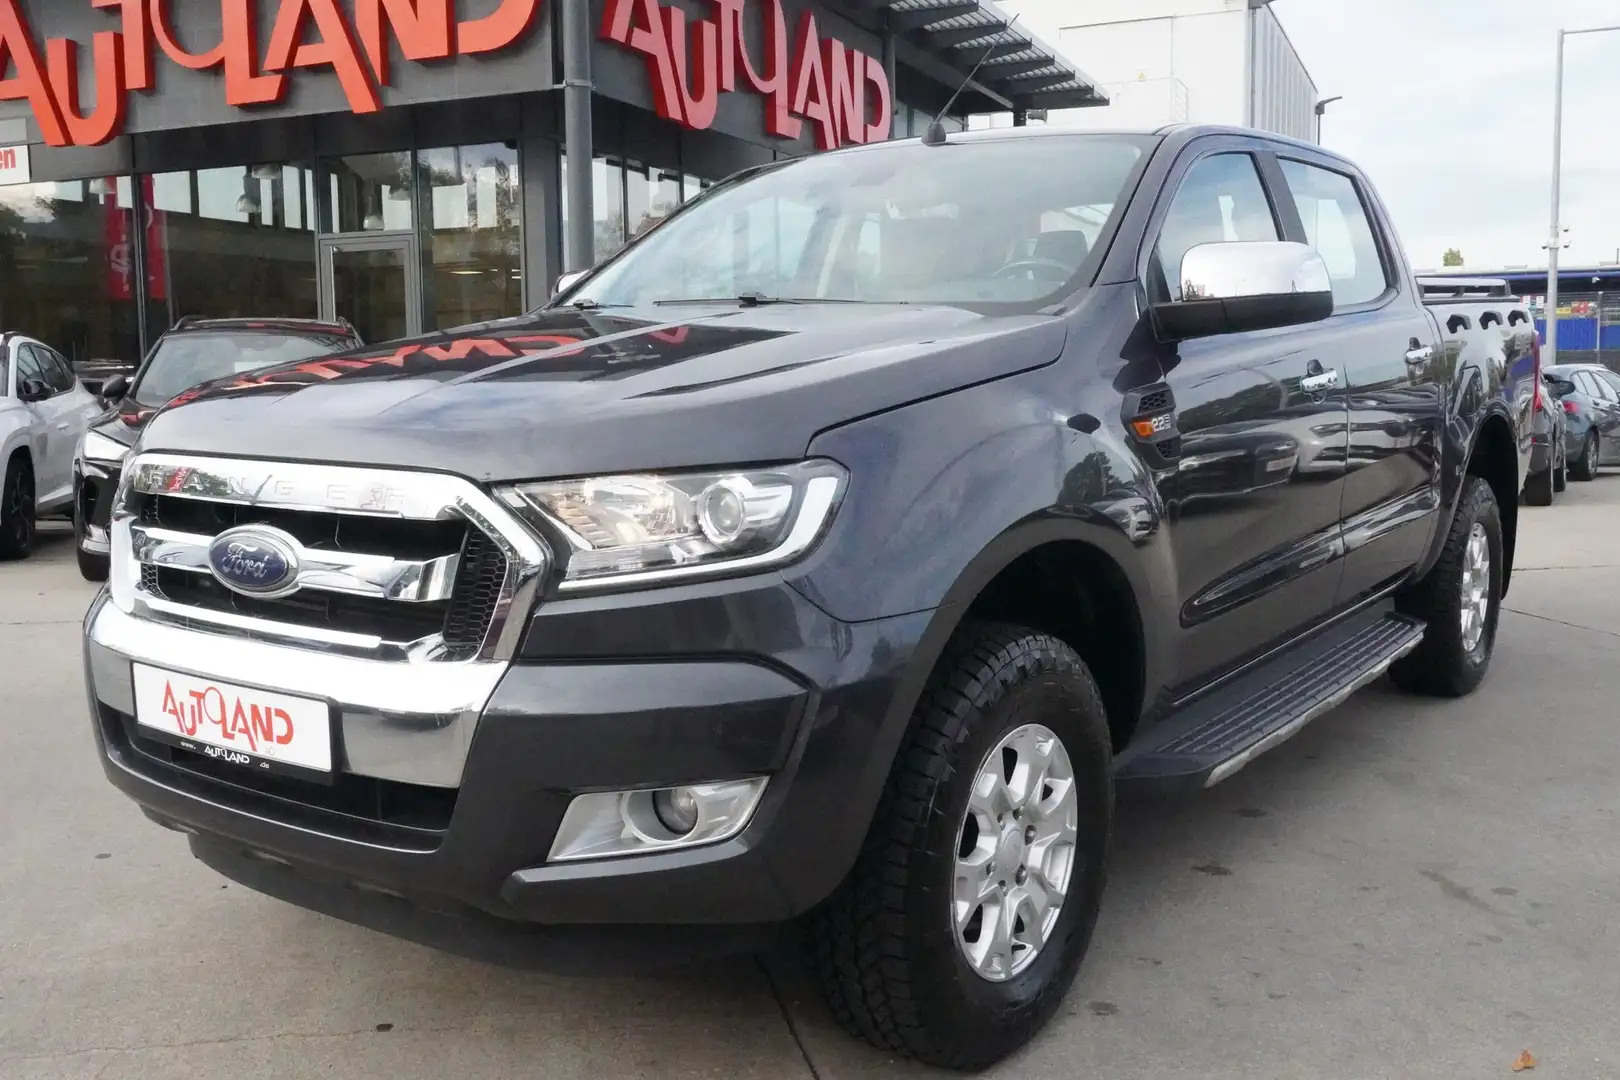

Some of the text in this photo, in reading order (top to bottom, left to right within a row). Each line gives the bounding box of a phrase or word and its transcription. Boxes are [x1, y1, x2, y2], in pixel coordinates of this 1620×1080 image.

[601, 0, 891, 150] AUTOLAND
[221, 542, 270, 578] Ford
[162, 679, 294, 752] AUTOLAND
[204, 745, 250, 763] AUTOLAND
